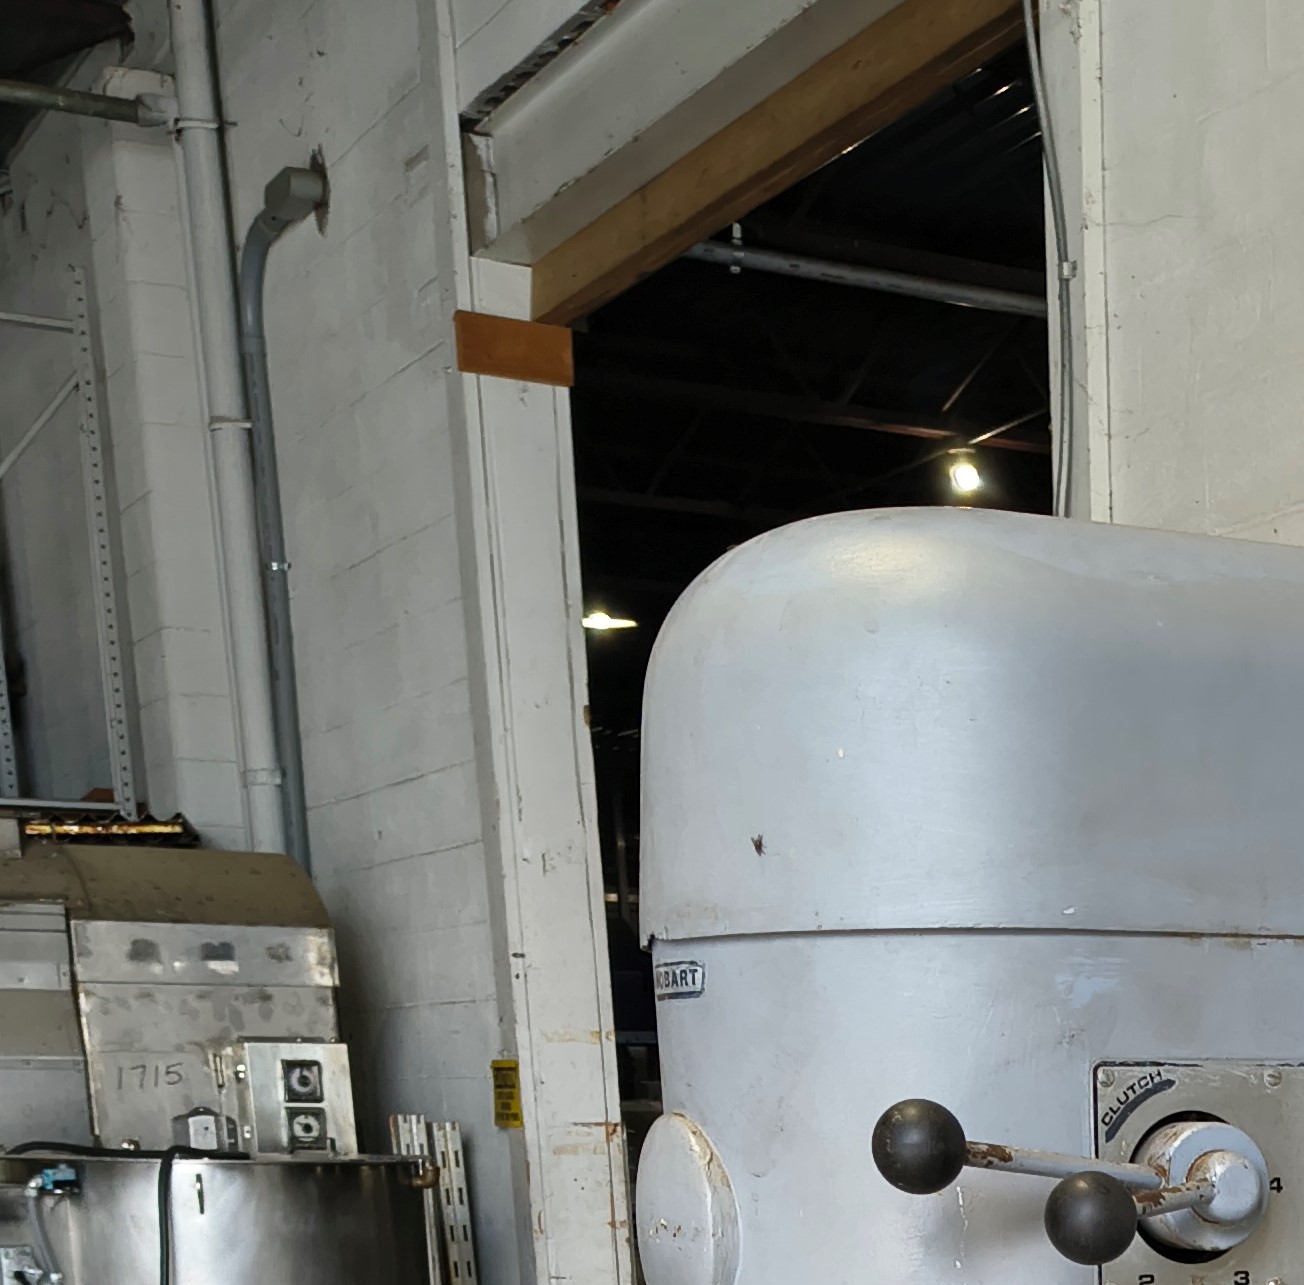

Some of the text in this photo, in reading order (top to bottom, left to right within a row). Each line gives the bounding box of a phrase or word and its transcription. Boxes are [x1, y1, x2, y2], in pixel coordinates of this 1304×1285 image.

[117, 1062, 184, 1093] 1715
[1101, 1069, 1163, 1127] CLUTCH
[1269, 1176, 1284, 1194] 4
